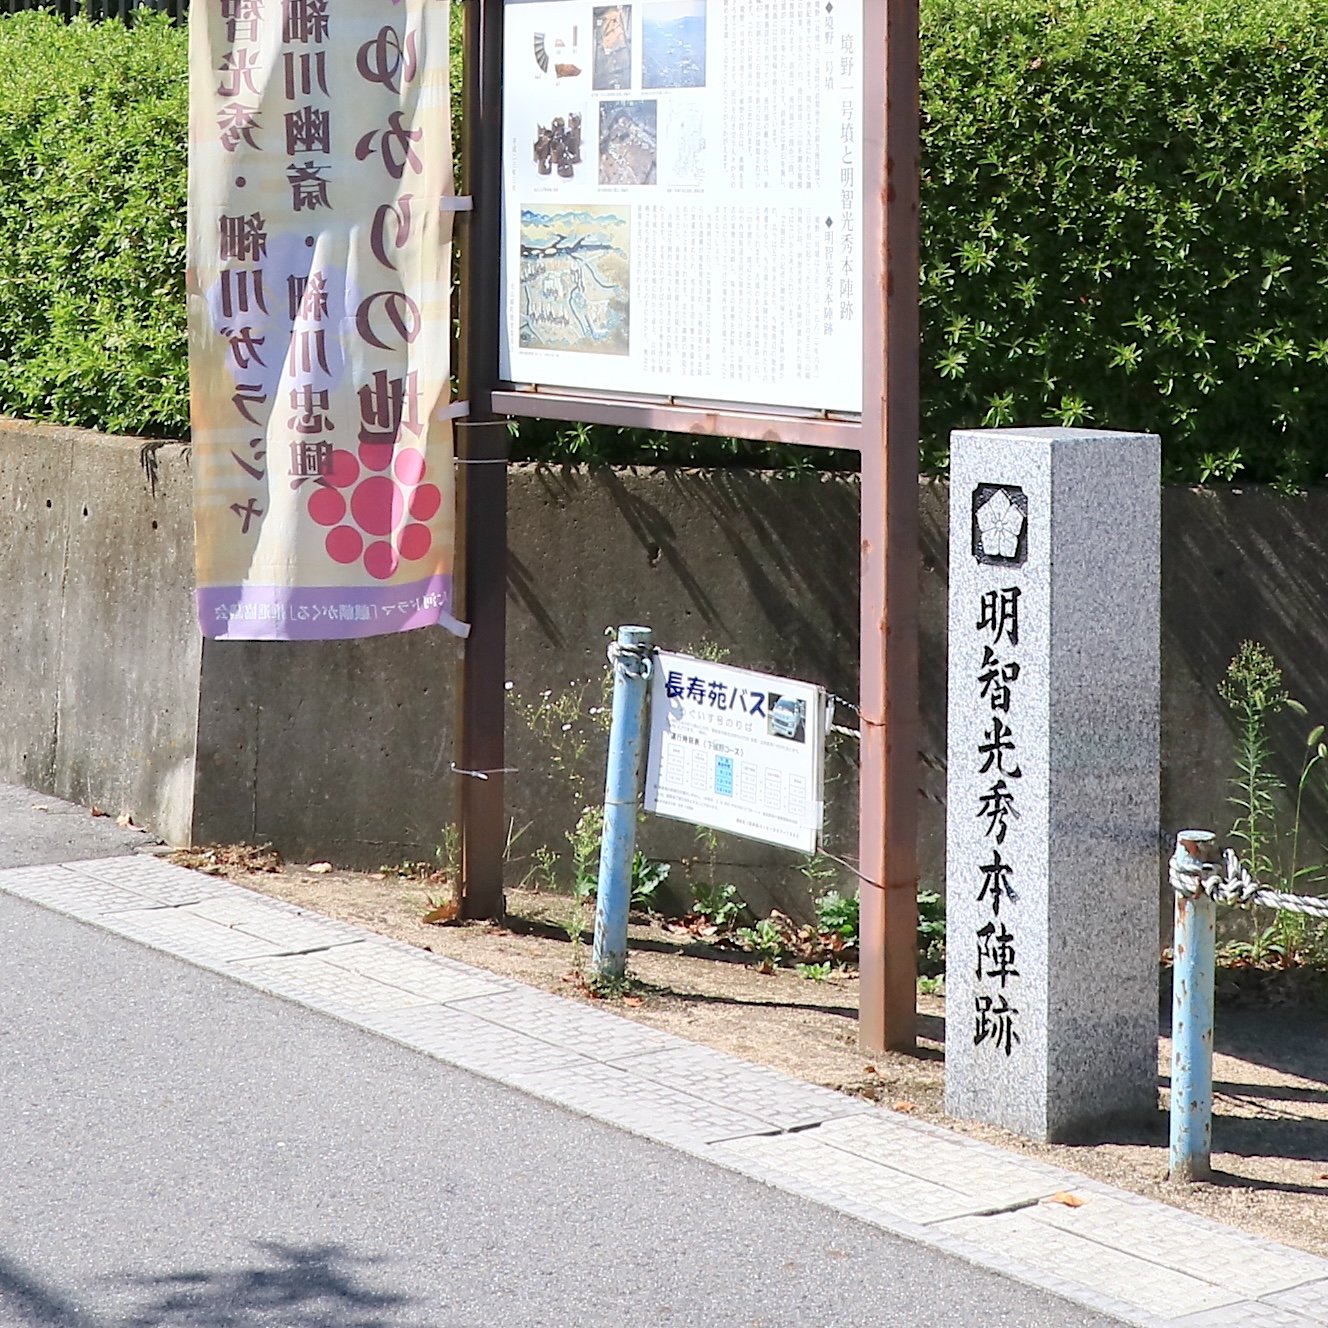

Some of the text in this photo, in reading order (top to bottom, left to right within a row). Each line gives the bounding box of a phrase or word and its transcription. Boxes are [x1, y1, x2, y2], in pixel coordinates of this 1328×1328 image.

[840, 34, 854, 321] 境野一号墳と明智光秀本陣跡
[665, 670, 766, 719] 長寿苑バス
[681, 708, 753, 733] ぐいす号のりば
[973, 586, 1022, 1056] 明智光秀本陣跡
